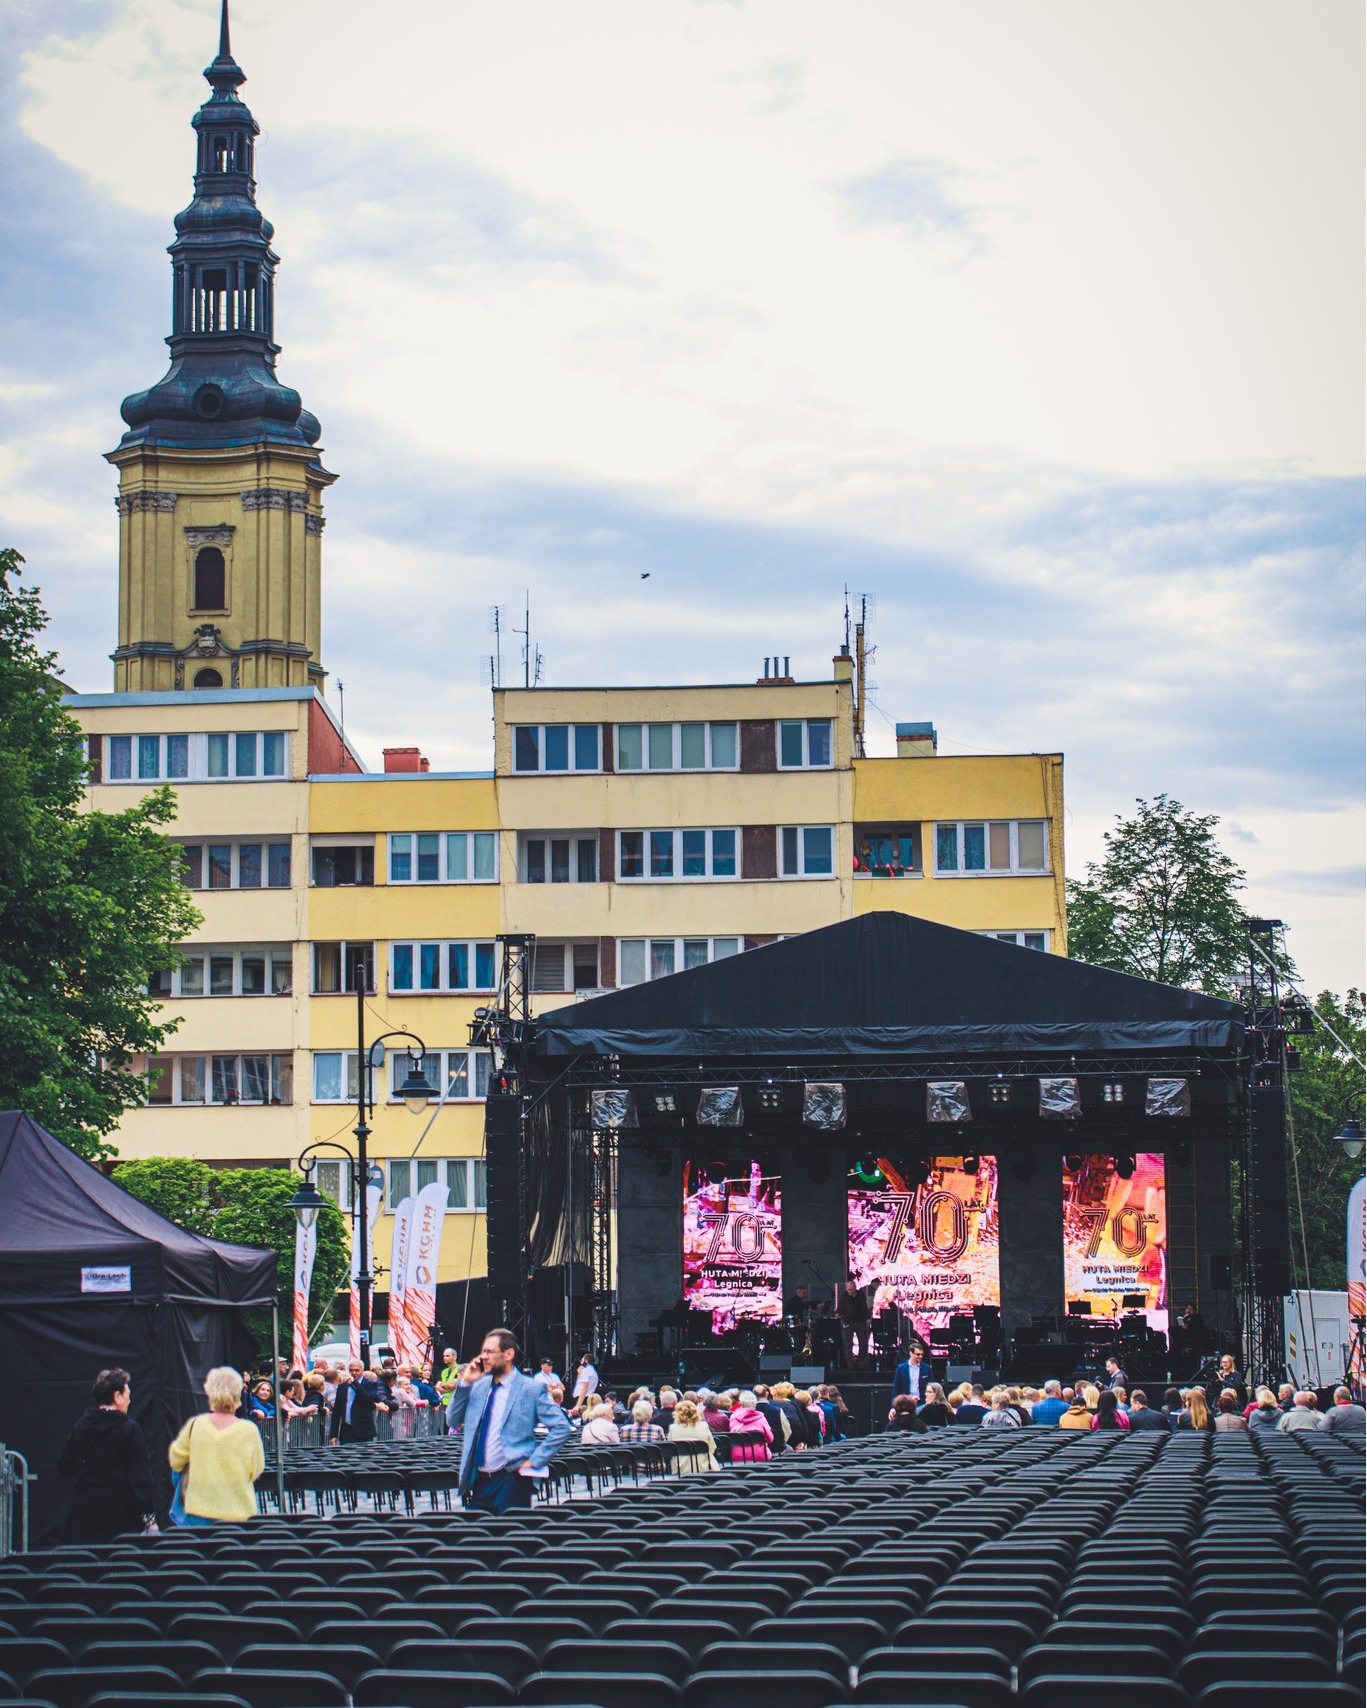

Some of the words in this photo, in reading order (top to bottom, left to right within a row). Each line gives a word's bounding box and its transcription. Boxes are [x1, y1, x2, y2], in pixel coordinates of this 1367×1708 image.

[418, 1205, 433, 1260] KGHM
[873, 1190, 969, 1264] 70
[1080, 1206, 1147, 1258] 70
[701, 1213, 765, 1263] 70
[701, 1269, 729, 1278] HUTA
[1082, 1265, 1111, 1274] HUTA
[1113, 1265, 1149, 1274] MIEDZI
[714, 1279, 753, 1290] Legnica
[921, 1274, 971, 1285] MIEDZI
[1096, 1275, 1136, 1285] Legnica
[897, 1289, 954, 1302] Legnica
[1287, 1295, 1295, 1306] 4
